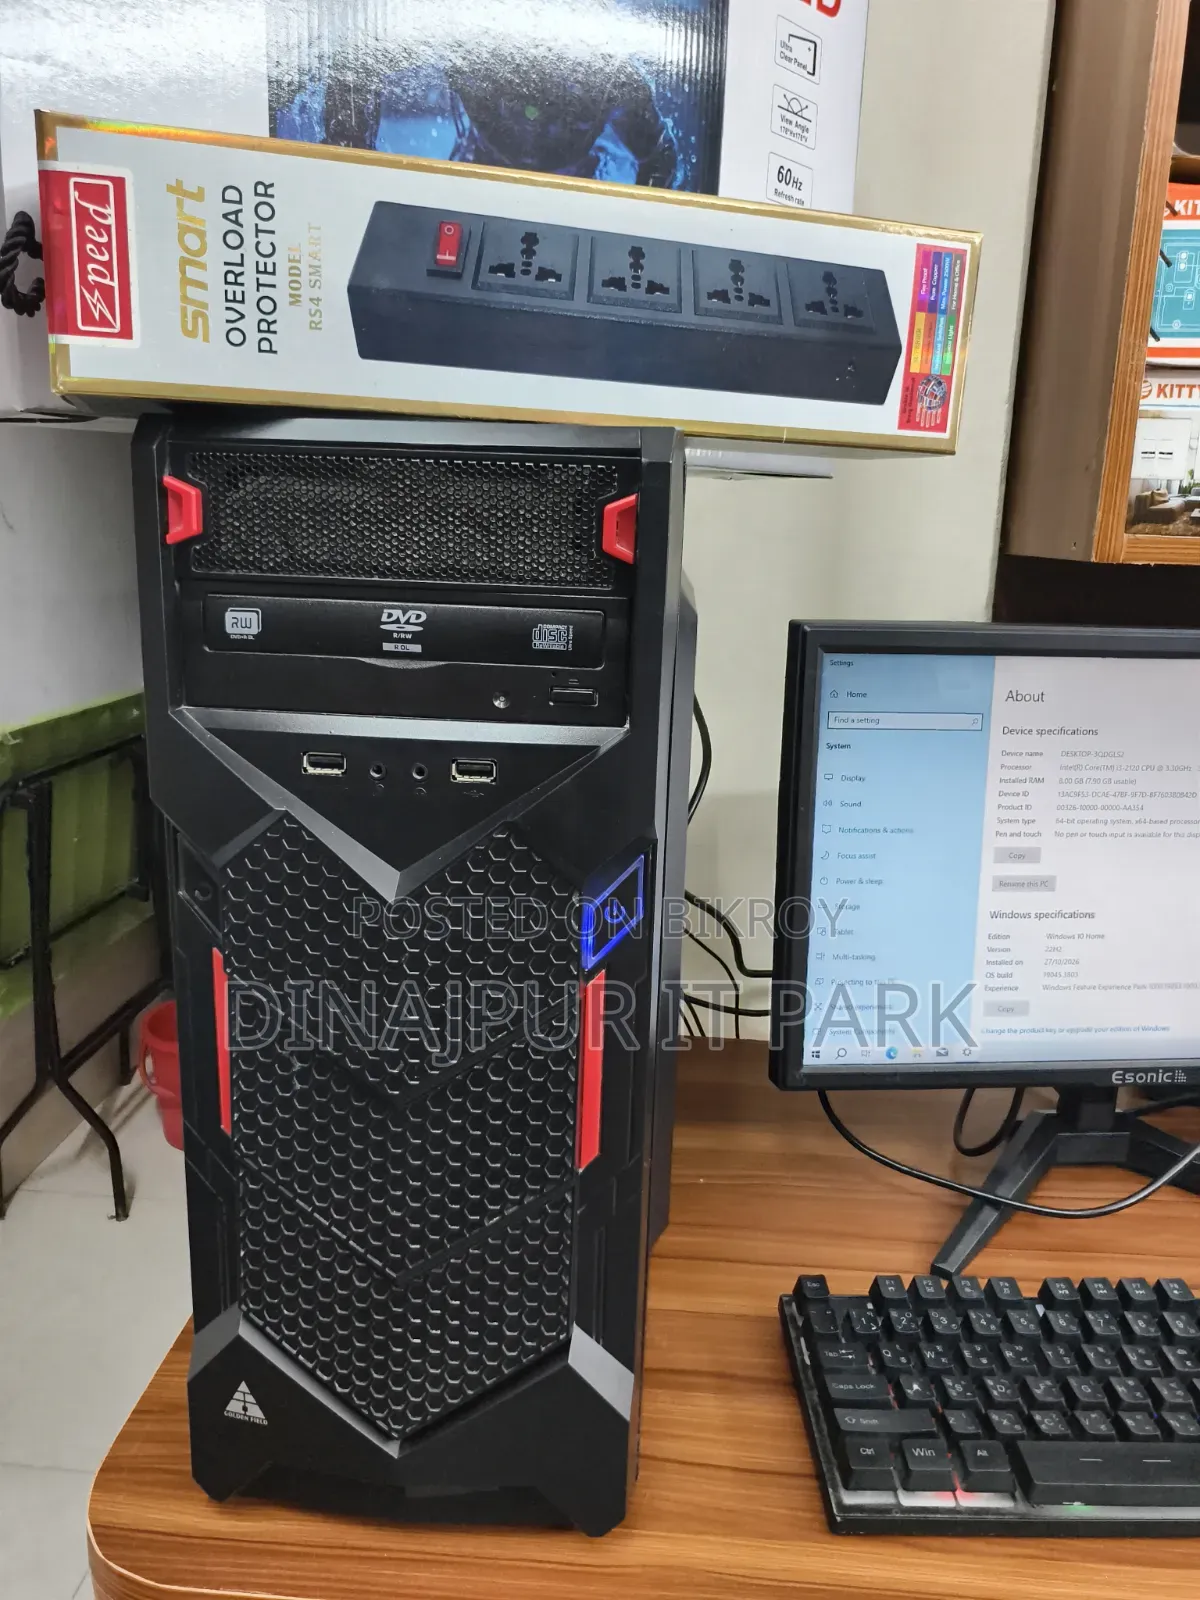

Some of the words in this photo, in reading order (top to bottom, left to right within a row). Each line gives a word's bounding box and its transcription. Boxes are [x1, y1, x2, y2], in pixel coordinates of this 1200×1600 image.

[780, 50, 793, 64] Clear
[794, 57, 808, 71] Panel
[780, 113, 793, 126] View
[795, 120, 809, 134] Angle
[777, 165, 803, 191] 60Hz
[774, 188, 794, 203] Refresh
[166, 178, 210, 343] smart
[308, 222, 322, 289] SMART
[222, 184, 247, 348] OVERLOAD
[253, 180, 278, 355] PROTECTOR
[953, 259, 961, 276] Office
[287, 242, 302, 307] MODEL
[930, 263, 939, 286] Copper
[308, 297, 323, 331] RS4
[1156, 383, 1200, 399] KITT
[231, 616, 252, 629] RW
[380, 609, 427, 624] DVD
[532, 624, 568, 643] disc
[829, 659, 854, 668] Settings
[1005, 690, 1045, 703] About
[834, 716, 849, 724] Find
[856, 716, 880, 725] setting
[1002, 726, 1033, 736] Device
[1036, 726, 1099, 737] specifications
[1059, 764, 1083, 772] Intel(R)
[1084, 764, 1115, 772] Core(TM)
[841, 775, 866, 783] Display
[1113, 778, 1137, 786] usable)
[996, 817, 1020, 825] System
[1077, 818, 1108, 826] operating
[1108, 831, 1126, 839] input
[1008, 852, 1026, 860] Copy
[865, 878, 883, 886] sleep
[999, 880, 1026, 888] Rename
[1026, 880, 1039, 888] this
[1040, 880, 1049, 888] PC
[989, 910, 1032, 919] Windows
[1034, 910, 1095, 921] specifications
[1098, 984, 1132, 992] Experience
[1111, 1069, 1172, 1084] Esonic
[224, 1410, 249, 1421] GOLDEN
[250, 1416, 268, 1425] FIELD
[912, 1448, 936, 1457] Win
[976, 1449, 989, 1457] Alt
